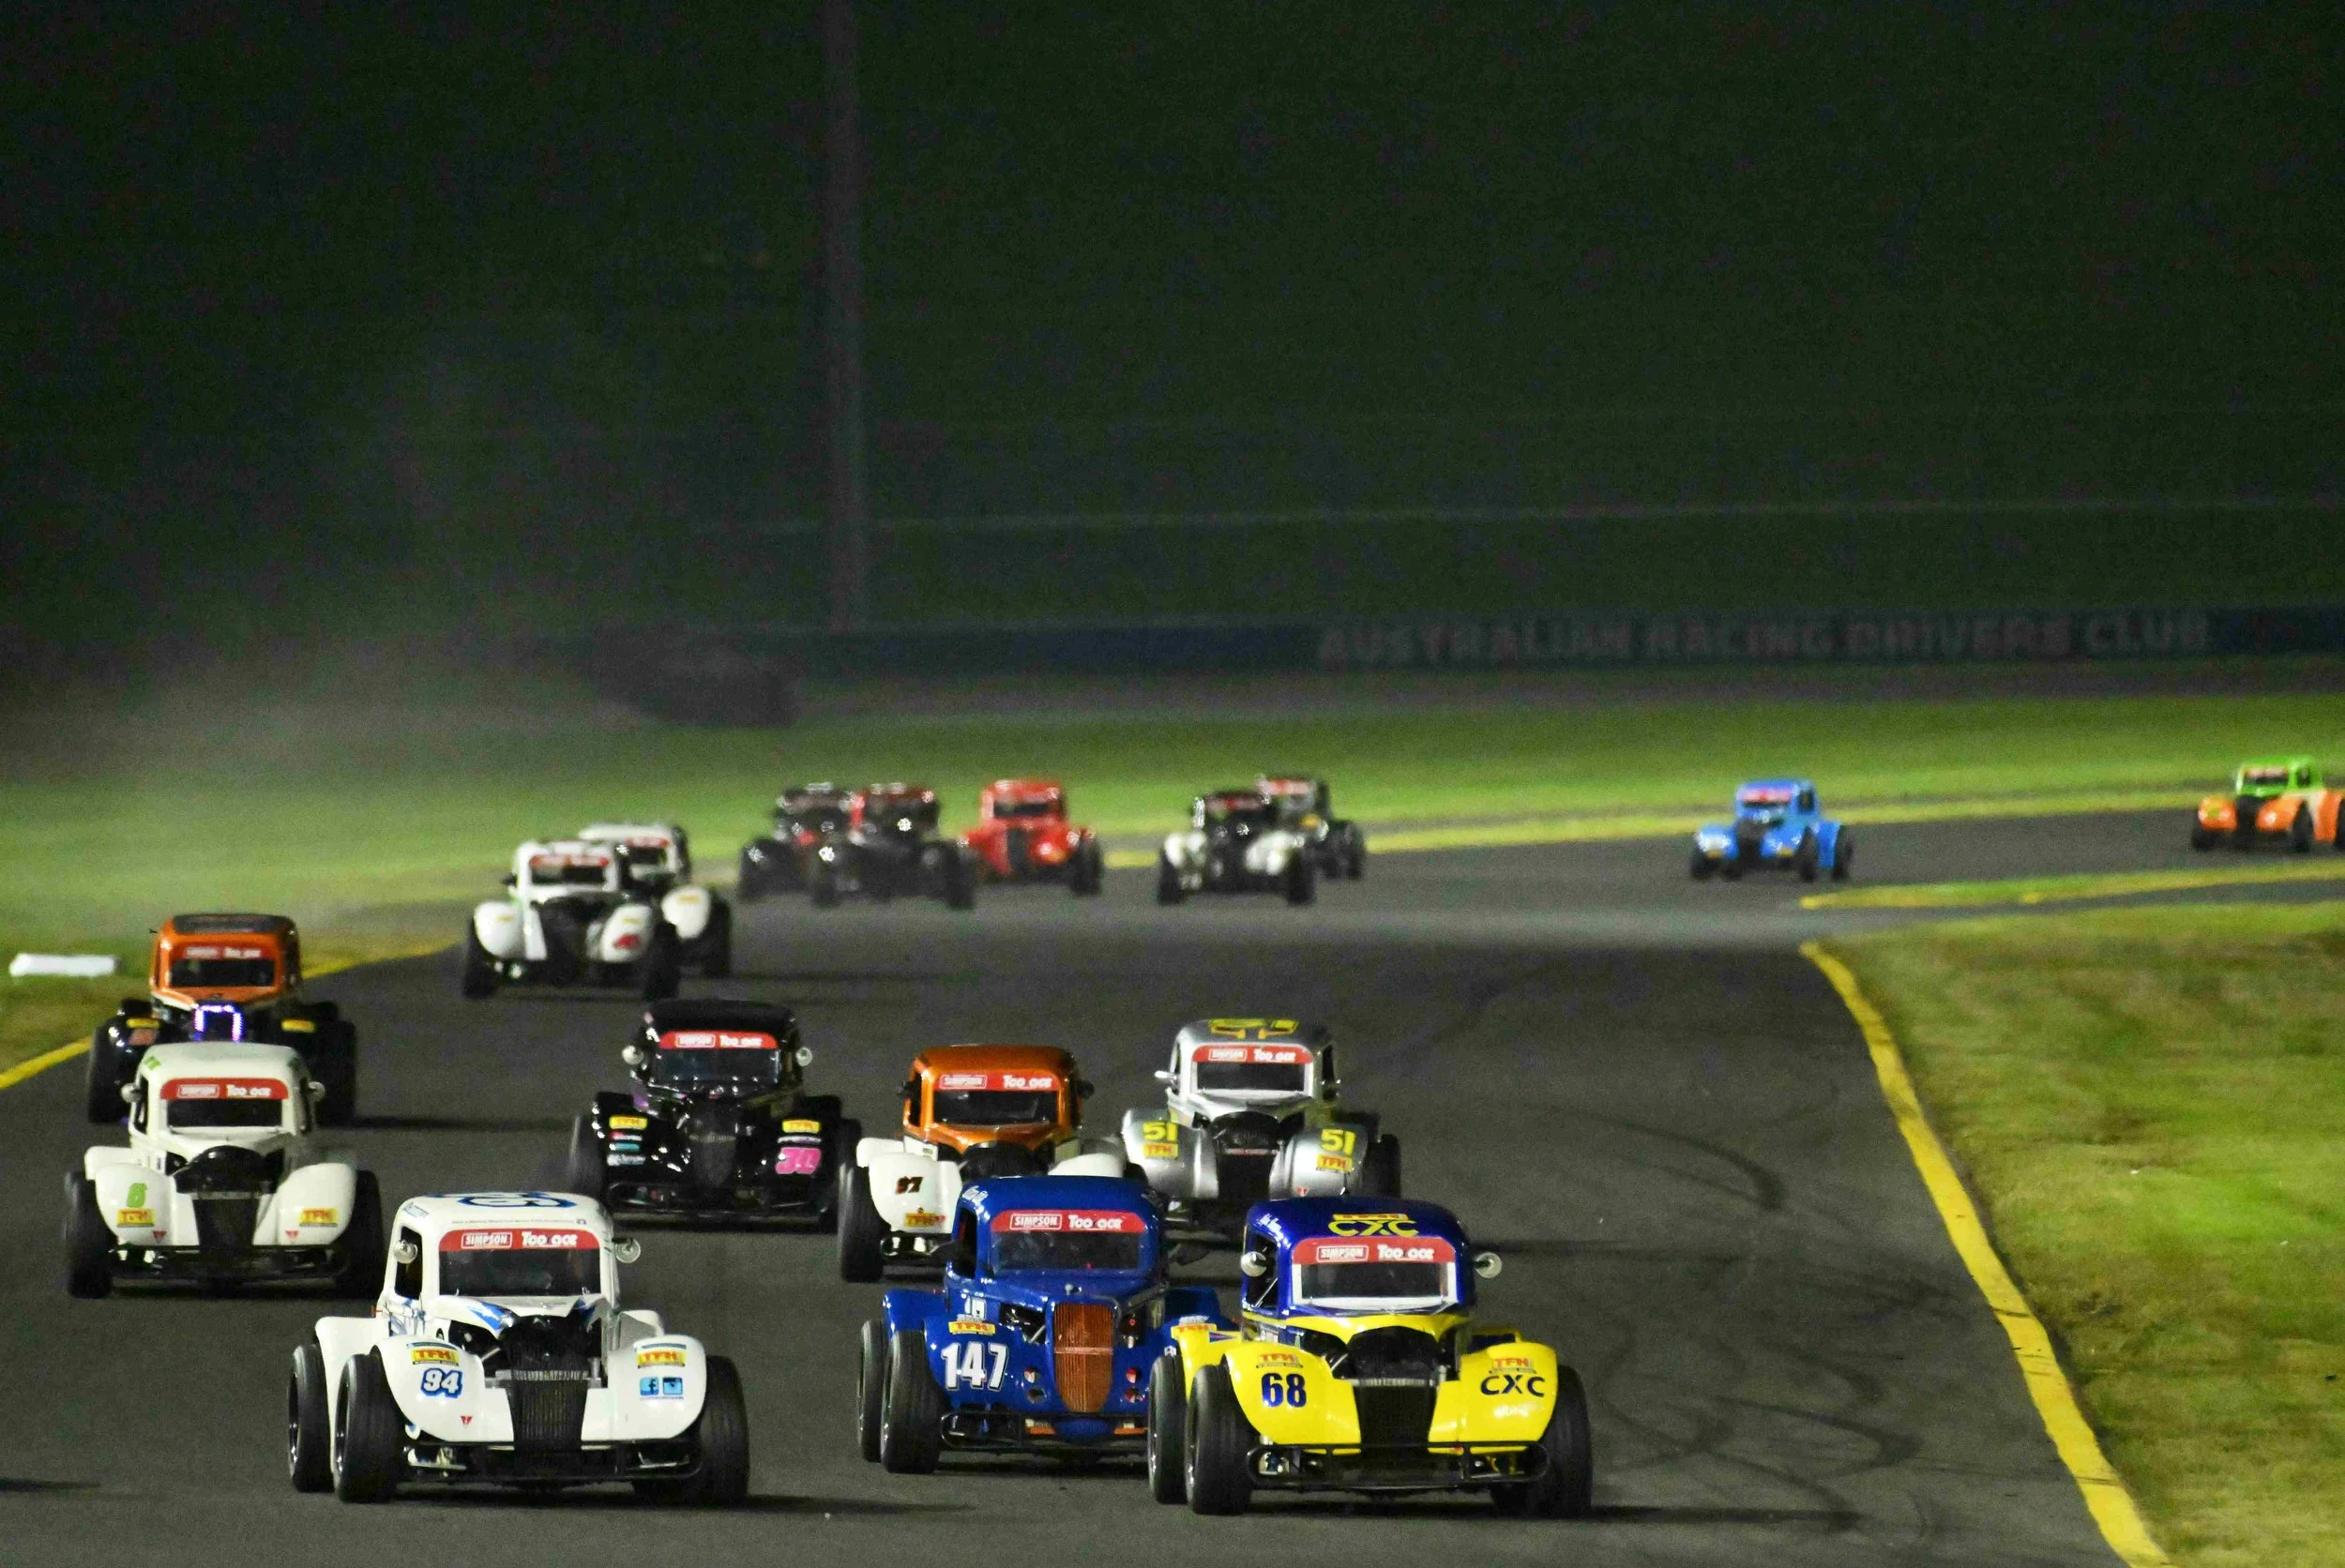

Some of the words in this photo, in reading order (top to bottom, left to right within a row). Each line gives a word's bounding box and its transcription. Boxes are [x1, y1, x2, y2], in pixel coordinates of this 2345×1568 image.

[1645, 621, 1835, 660] RACING
[1843, 619, 2075, 658] DRIVERS
[2085, 615, 2212, 652] CLUB
[1142, 1122, 1178, 1141] 51
[1321, 1128, 1356, 1155] 51
[1014, 1215, 1059, 1229] SIMPSON
[1327, 1220, 1420, 1238] CXC
[464, 1233, 509, 1247] SIMPSON
[1321, 1246, 1366, 1260] SIMPSON
[939, 1341, 1008, 1393] 147
[420, 1367, 463, 1399] 94
[1261, 1372, 1308, 1408] 68
[1480, 1374, 1546, 1397] CXC
